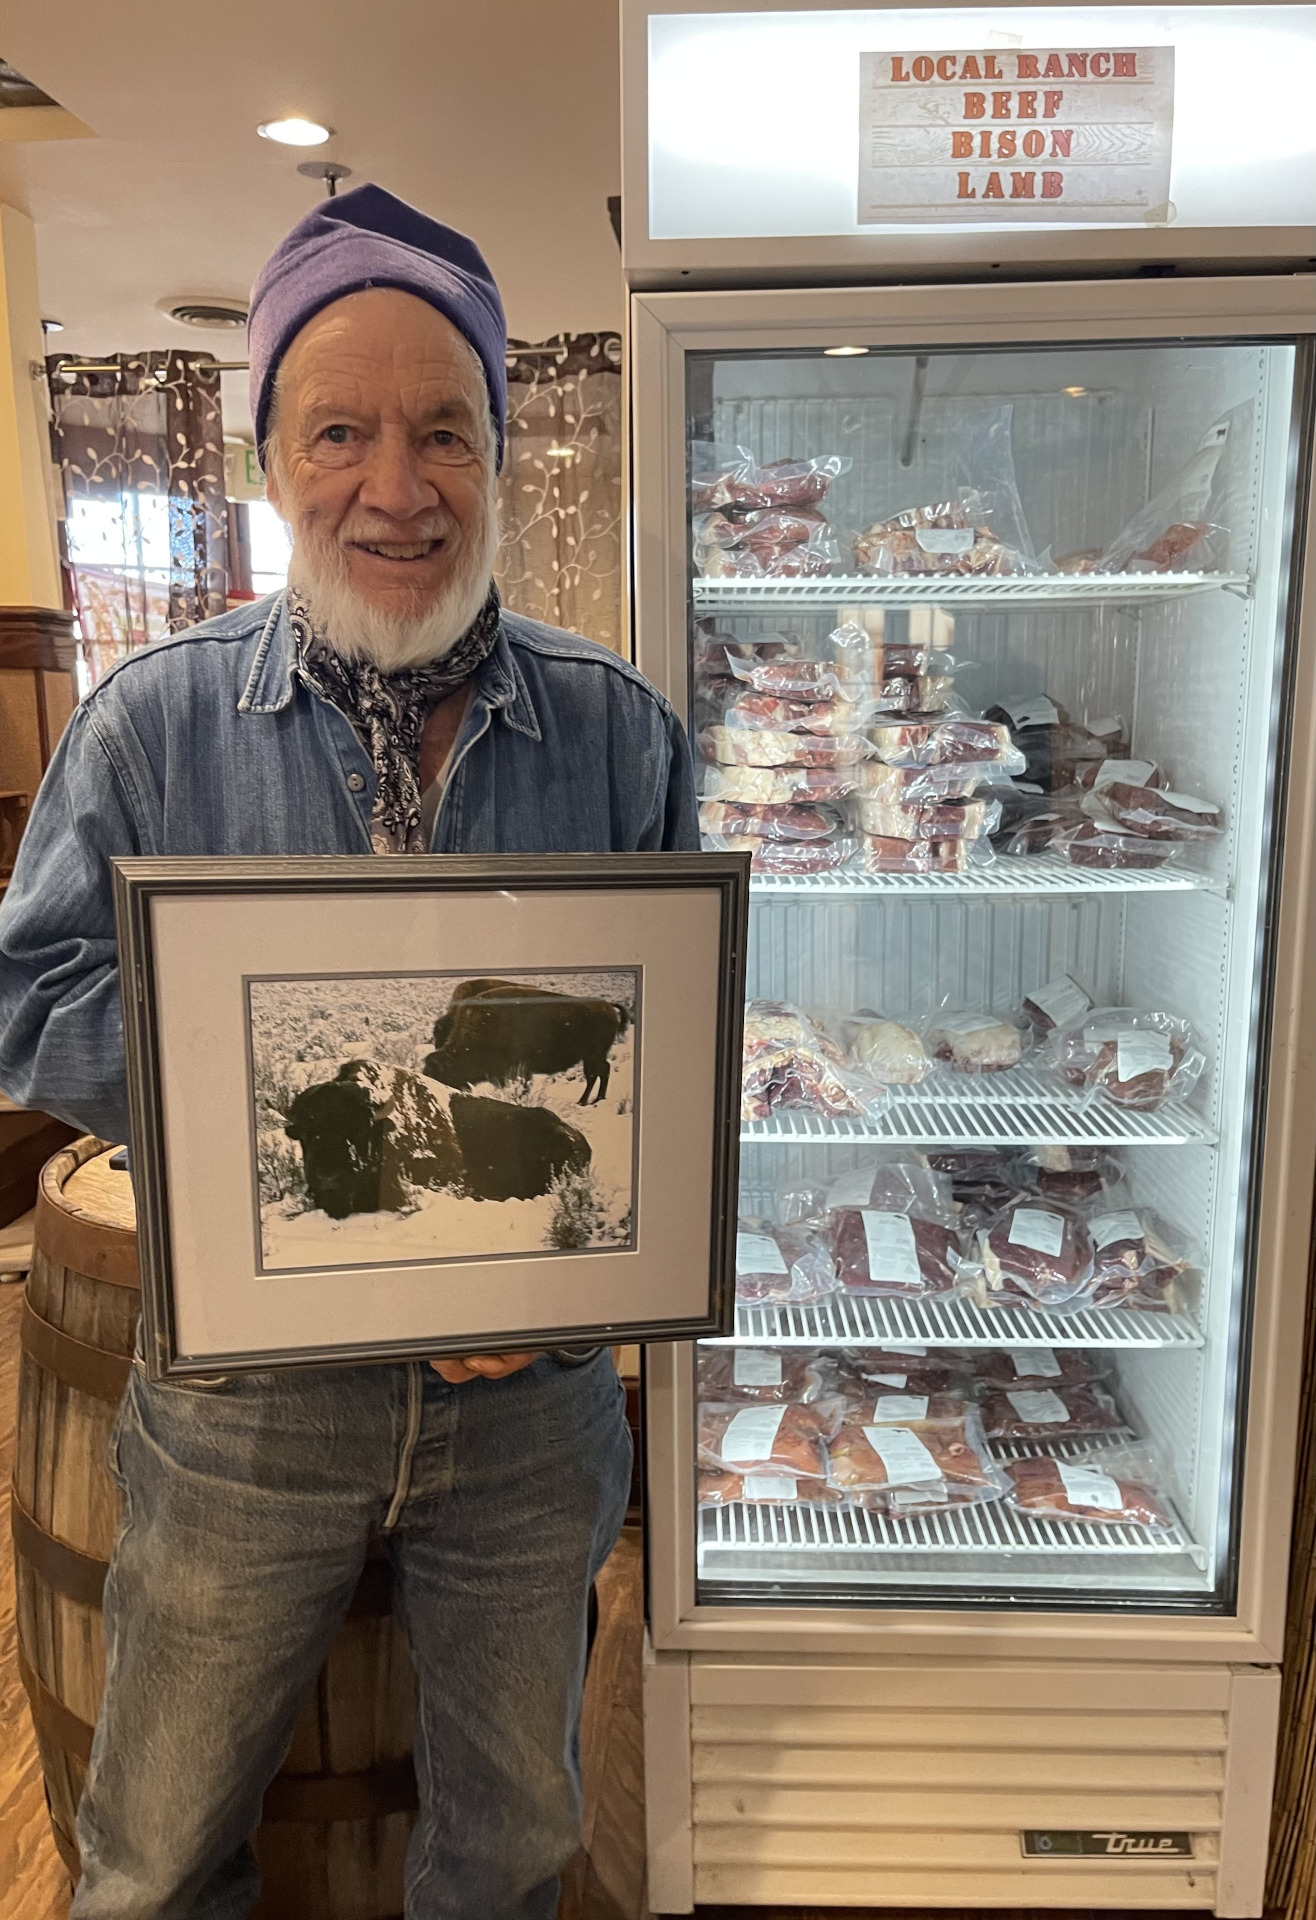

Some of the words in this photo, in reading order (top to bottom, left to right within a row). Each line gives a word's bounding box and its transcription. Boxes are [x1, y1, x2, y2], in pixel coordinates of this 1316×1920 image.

[891, 55, 1003, 82] LOCAL
[1017, 53, 1137, 79] RANCH
[963, 91, 1063, 119] BEEF
[951, 130, 1074, 158] BISON
[957, 171, 1064, 199] LAMB
[1092, 1833, 1181, 1853] True
